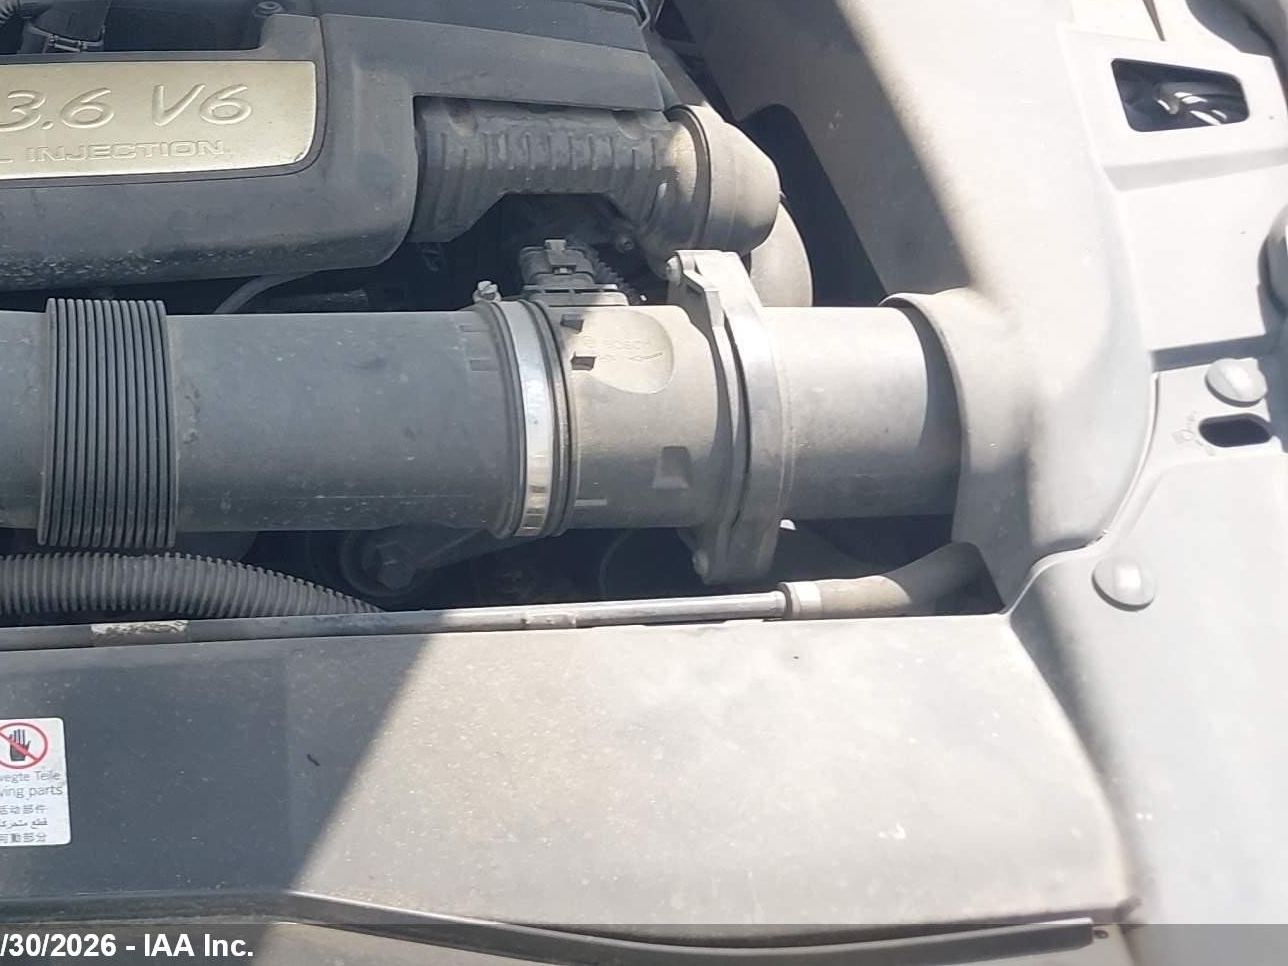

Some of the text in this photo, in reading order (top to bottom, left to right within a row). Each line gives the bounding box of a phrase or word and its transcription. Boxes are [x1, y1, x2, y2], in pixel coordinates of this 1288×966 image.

[151, 83, 252, 126] V6
[24, 139, 225, 163] INJECTION
[35, 770, 61, 781] Teile
[28, 785, 64, 798] parts
